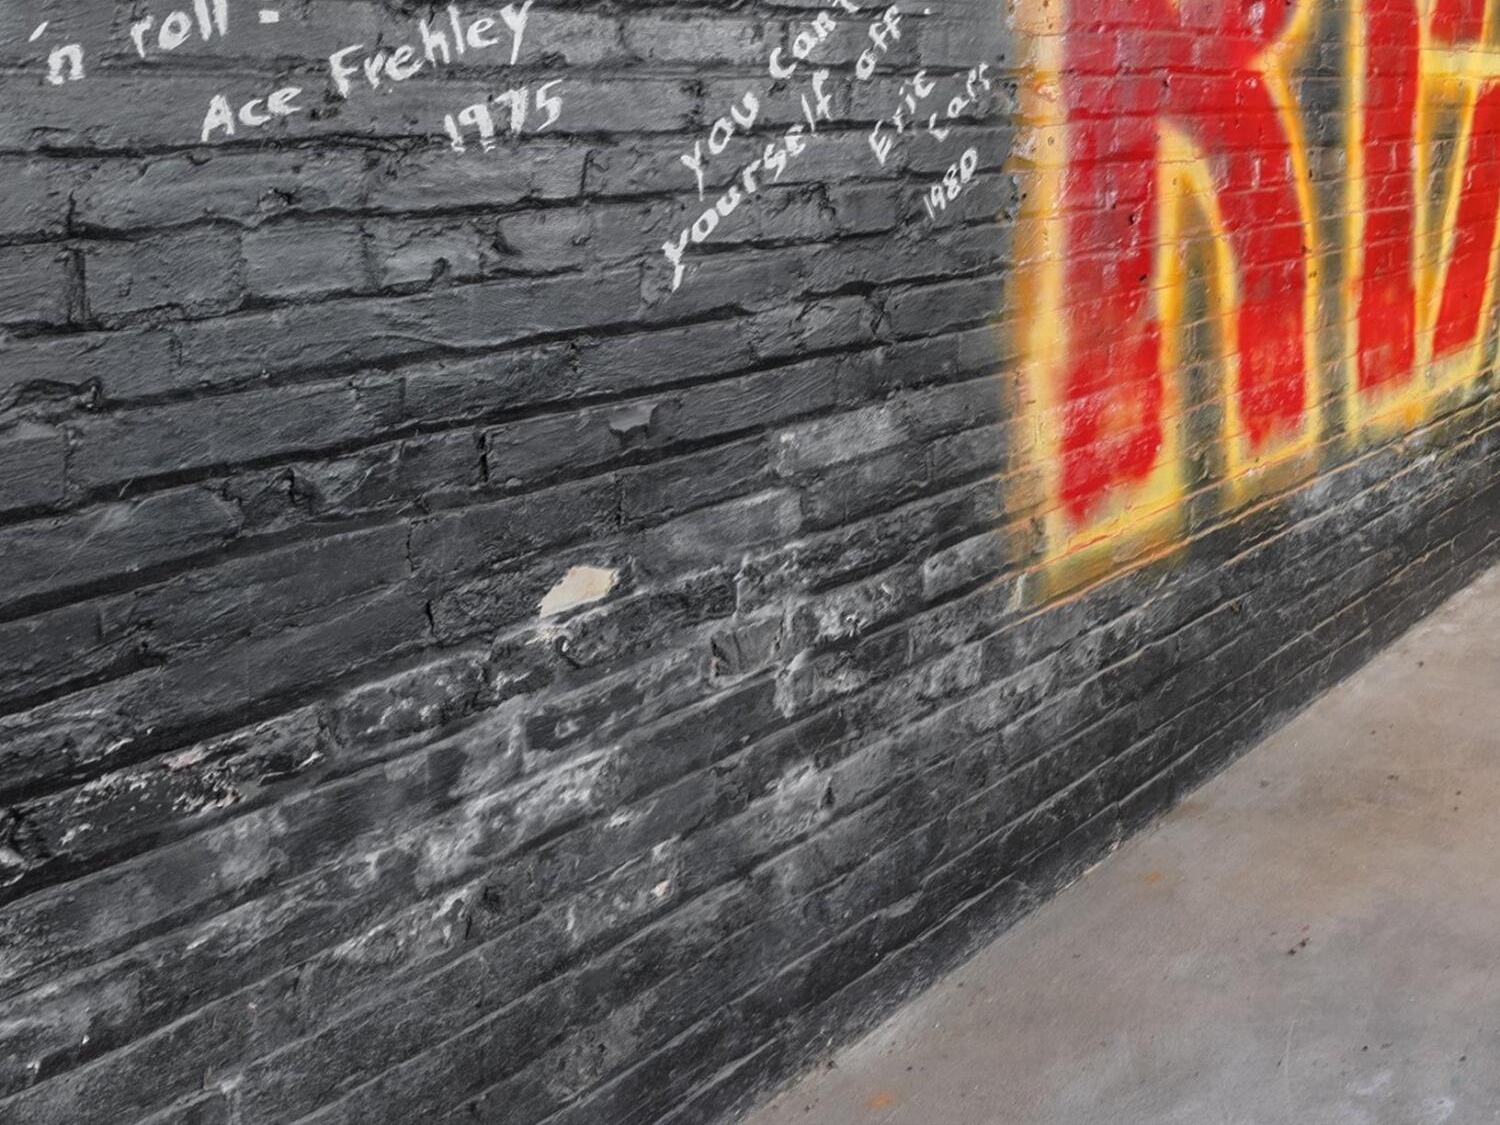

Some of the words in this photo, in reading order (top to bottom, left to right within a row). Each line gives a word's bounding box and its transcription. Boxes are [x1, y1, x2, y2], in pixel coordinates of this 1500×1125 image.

[199, 84, 303, 145] Ace
[442, 78, 565, 154] 1975
[922, 145, 979, 222] 1980
